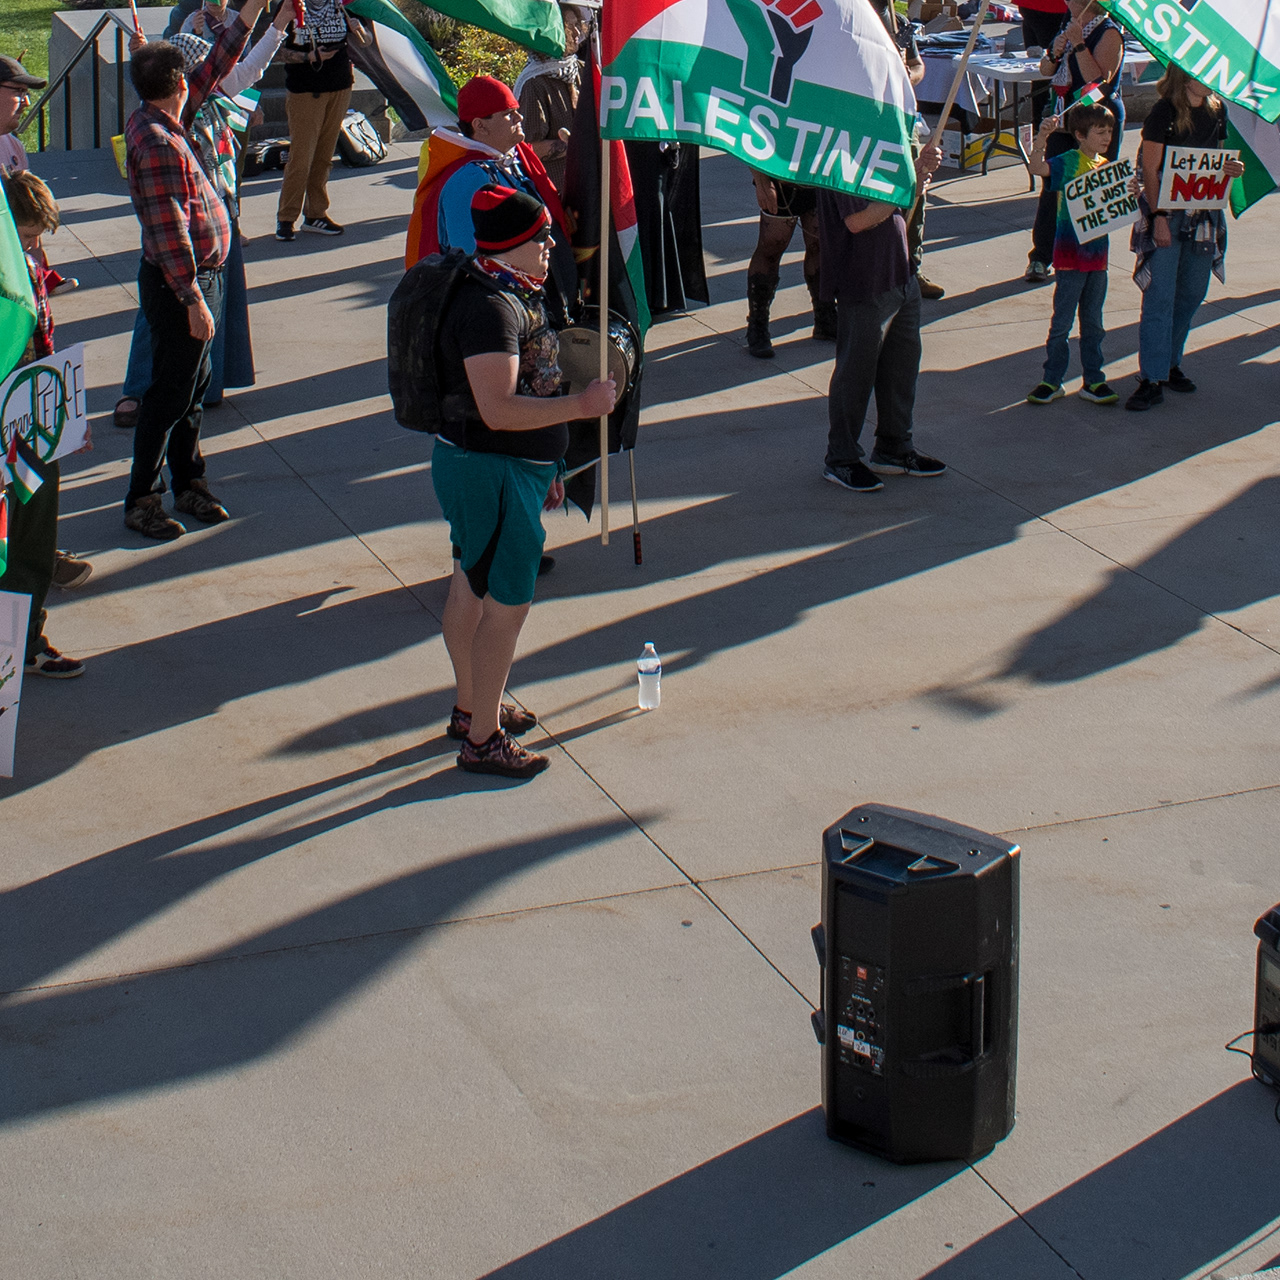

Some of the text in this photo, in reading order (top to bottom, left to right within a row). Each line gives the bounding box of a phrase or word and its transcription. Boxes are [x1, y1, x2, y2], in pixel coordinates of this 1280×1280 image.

[601, 75, 904, 195] PALESTINE
[1172, 151, 1223, 170] Let Aid
[1066, 160, 1133, 201] CEASEFIRE
[1171, 173, 1230, 201] NOW
[1083, 181, 1126, 210] IS JUST
[1076, 208, 1108, 232] THE
[35, 360, 83, 432] PEACE
